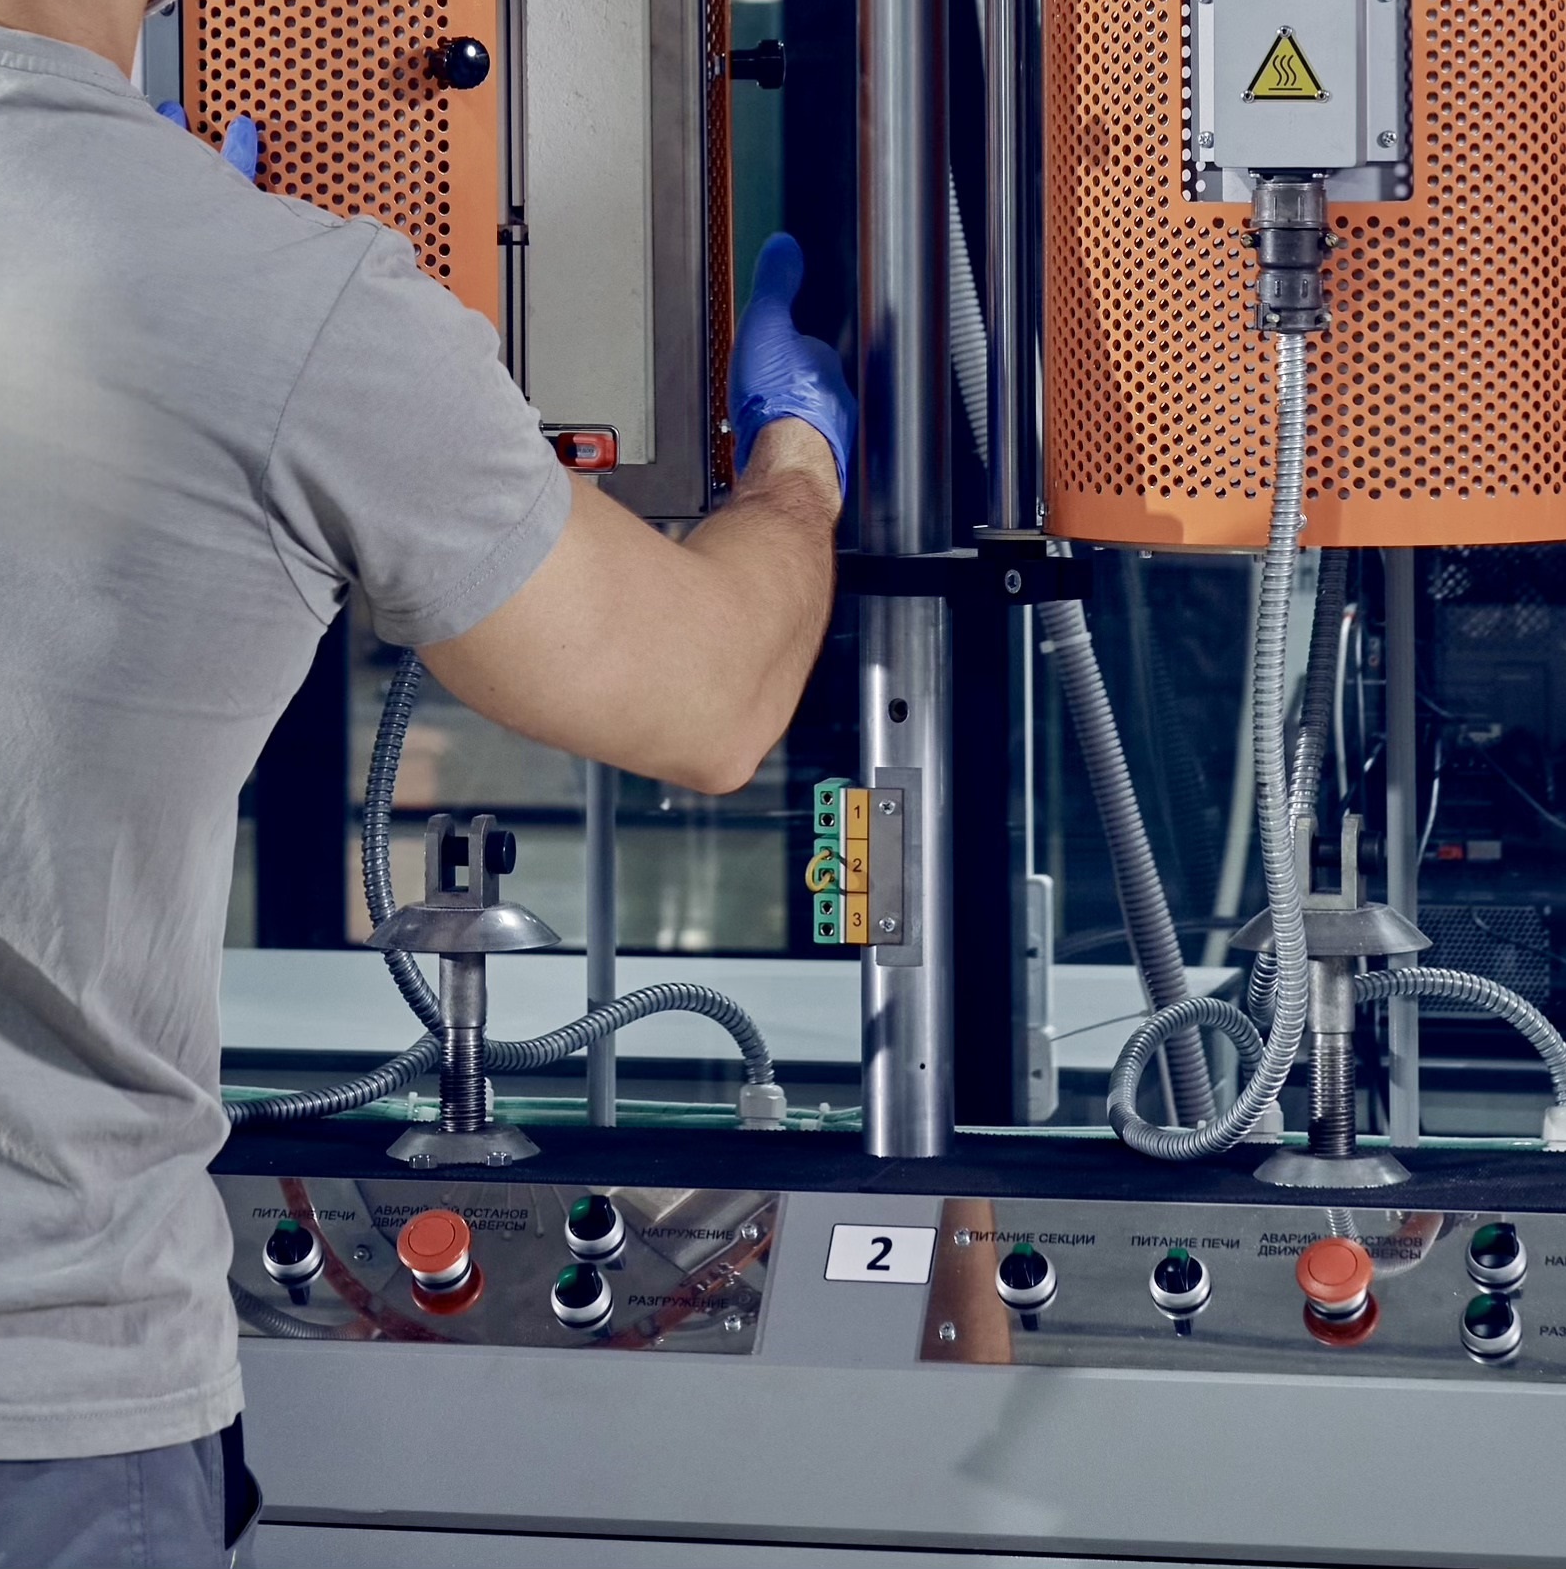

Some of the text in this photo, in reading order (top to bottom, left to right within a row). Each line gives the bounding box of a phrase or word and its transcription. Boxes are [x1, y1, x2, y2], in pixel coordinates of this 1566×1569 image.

[853, 805, 861, 819] 1
[852, 858, 862, 873] 2
[852, 912, 862, 927] 3
[319, 1209, 356, 1222] ПЕЧИ
[463, 1207, 529, 1220] ОСТАНОВ
[641, 1226, 734, 1242] НАГРУЖЕНИЕ
[970, 1231, 1096, 1246] ПИТАНИЕ СЕКЦИИ
[1131, 1235, 1241, 1249] ПИТАНИЕ ПЕЧИ
[866, 1236, 894, 1272] 2
[628, 1294, 730, 1309] РАЗГРУЖЕНИЕ
